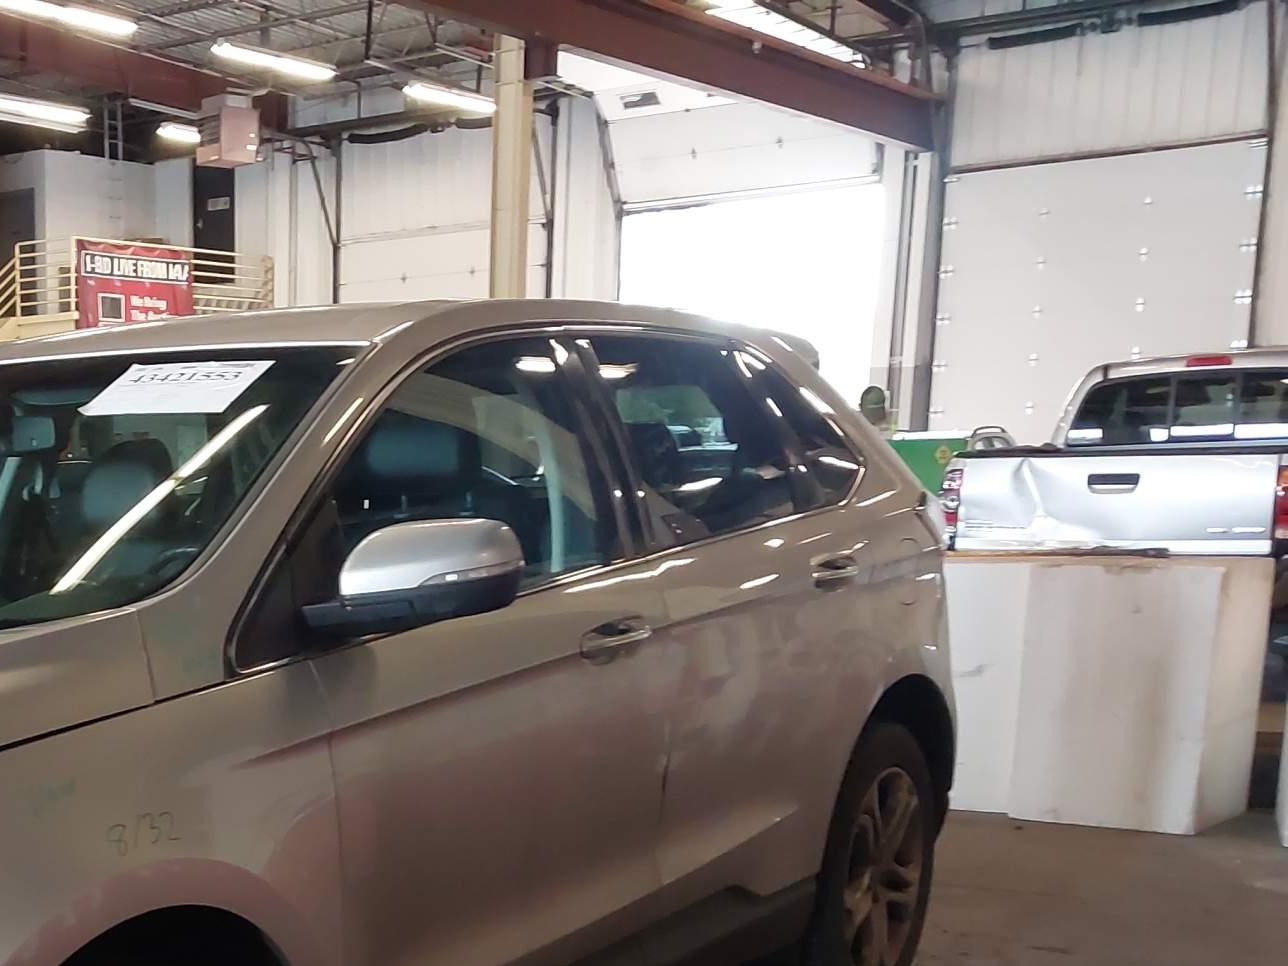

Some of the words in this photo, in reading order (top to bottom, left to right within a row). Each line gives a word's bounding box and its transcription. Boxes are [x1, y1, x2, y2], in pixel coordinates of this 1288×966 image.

[113, 257, 137, 277] LIVE
[137, 260, 168, 280] FROM
[128, 371, 242, 384] 43421553
